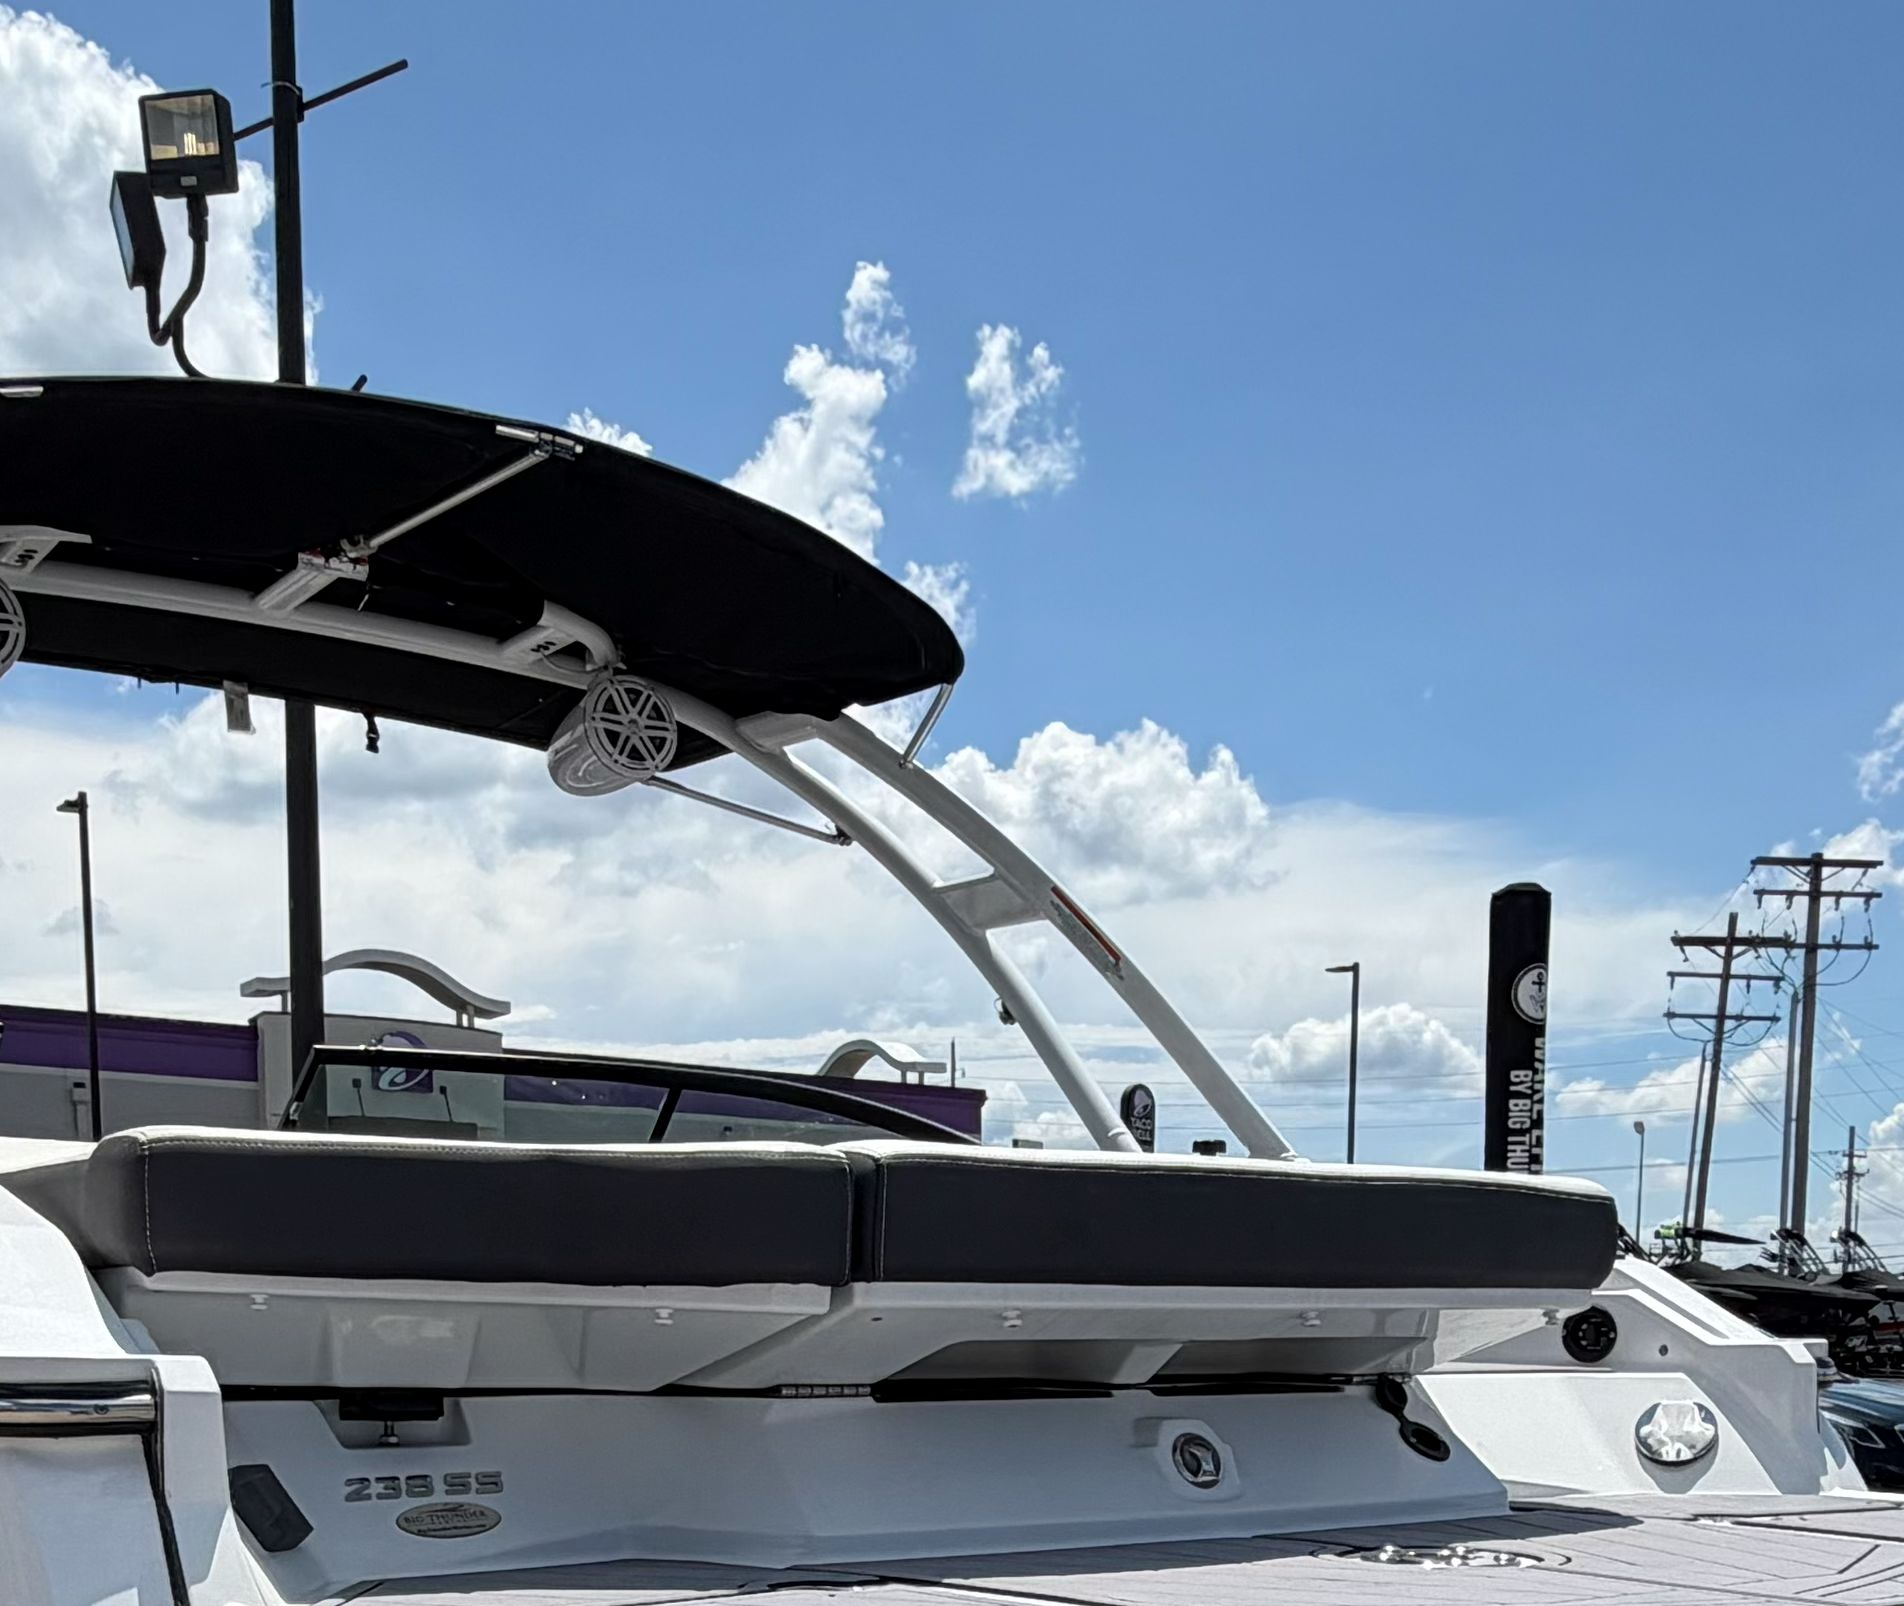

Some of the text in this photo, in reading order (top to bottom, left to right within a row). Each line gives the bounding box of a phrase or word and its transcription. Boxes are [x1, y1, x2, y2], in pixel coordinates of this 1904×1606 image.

[1506, 1069, 1533, 1174] BY BIG THU
[344, 1471, 504, 1502] 238 SS
